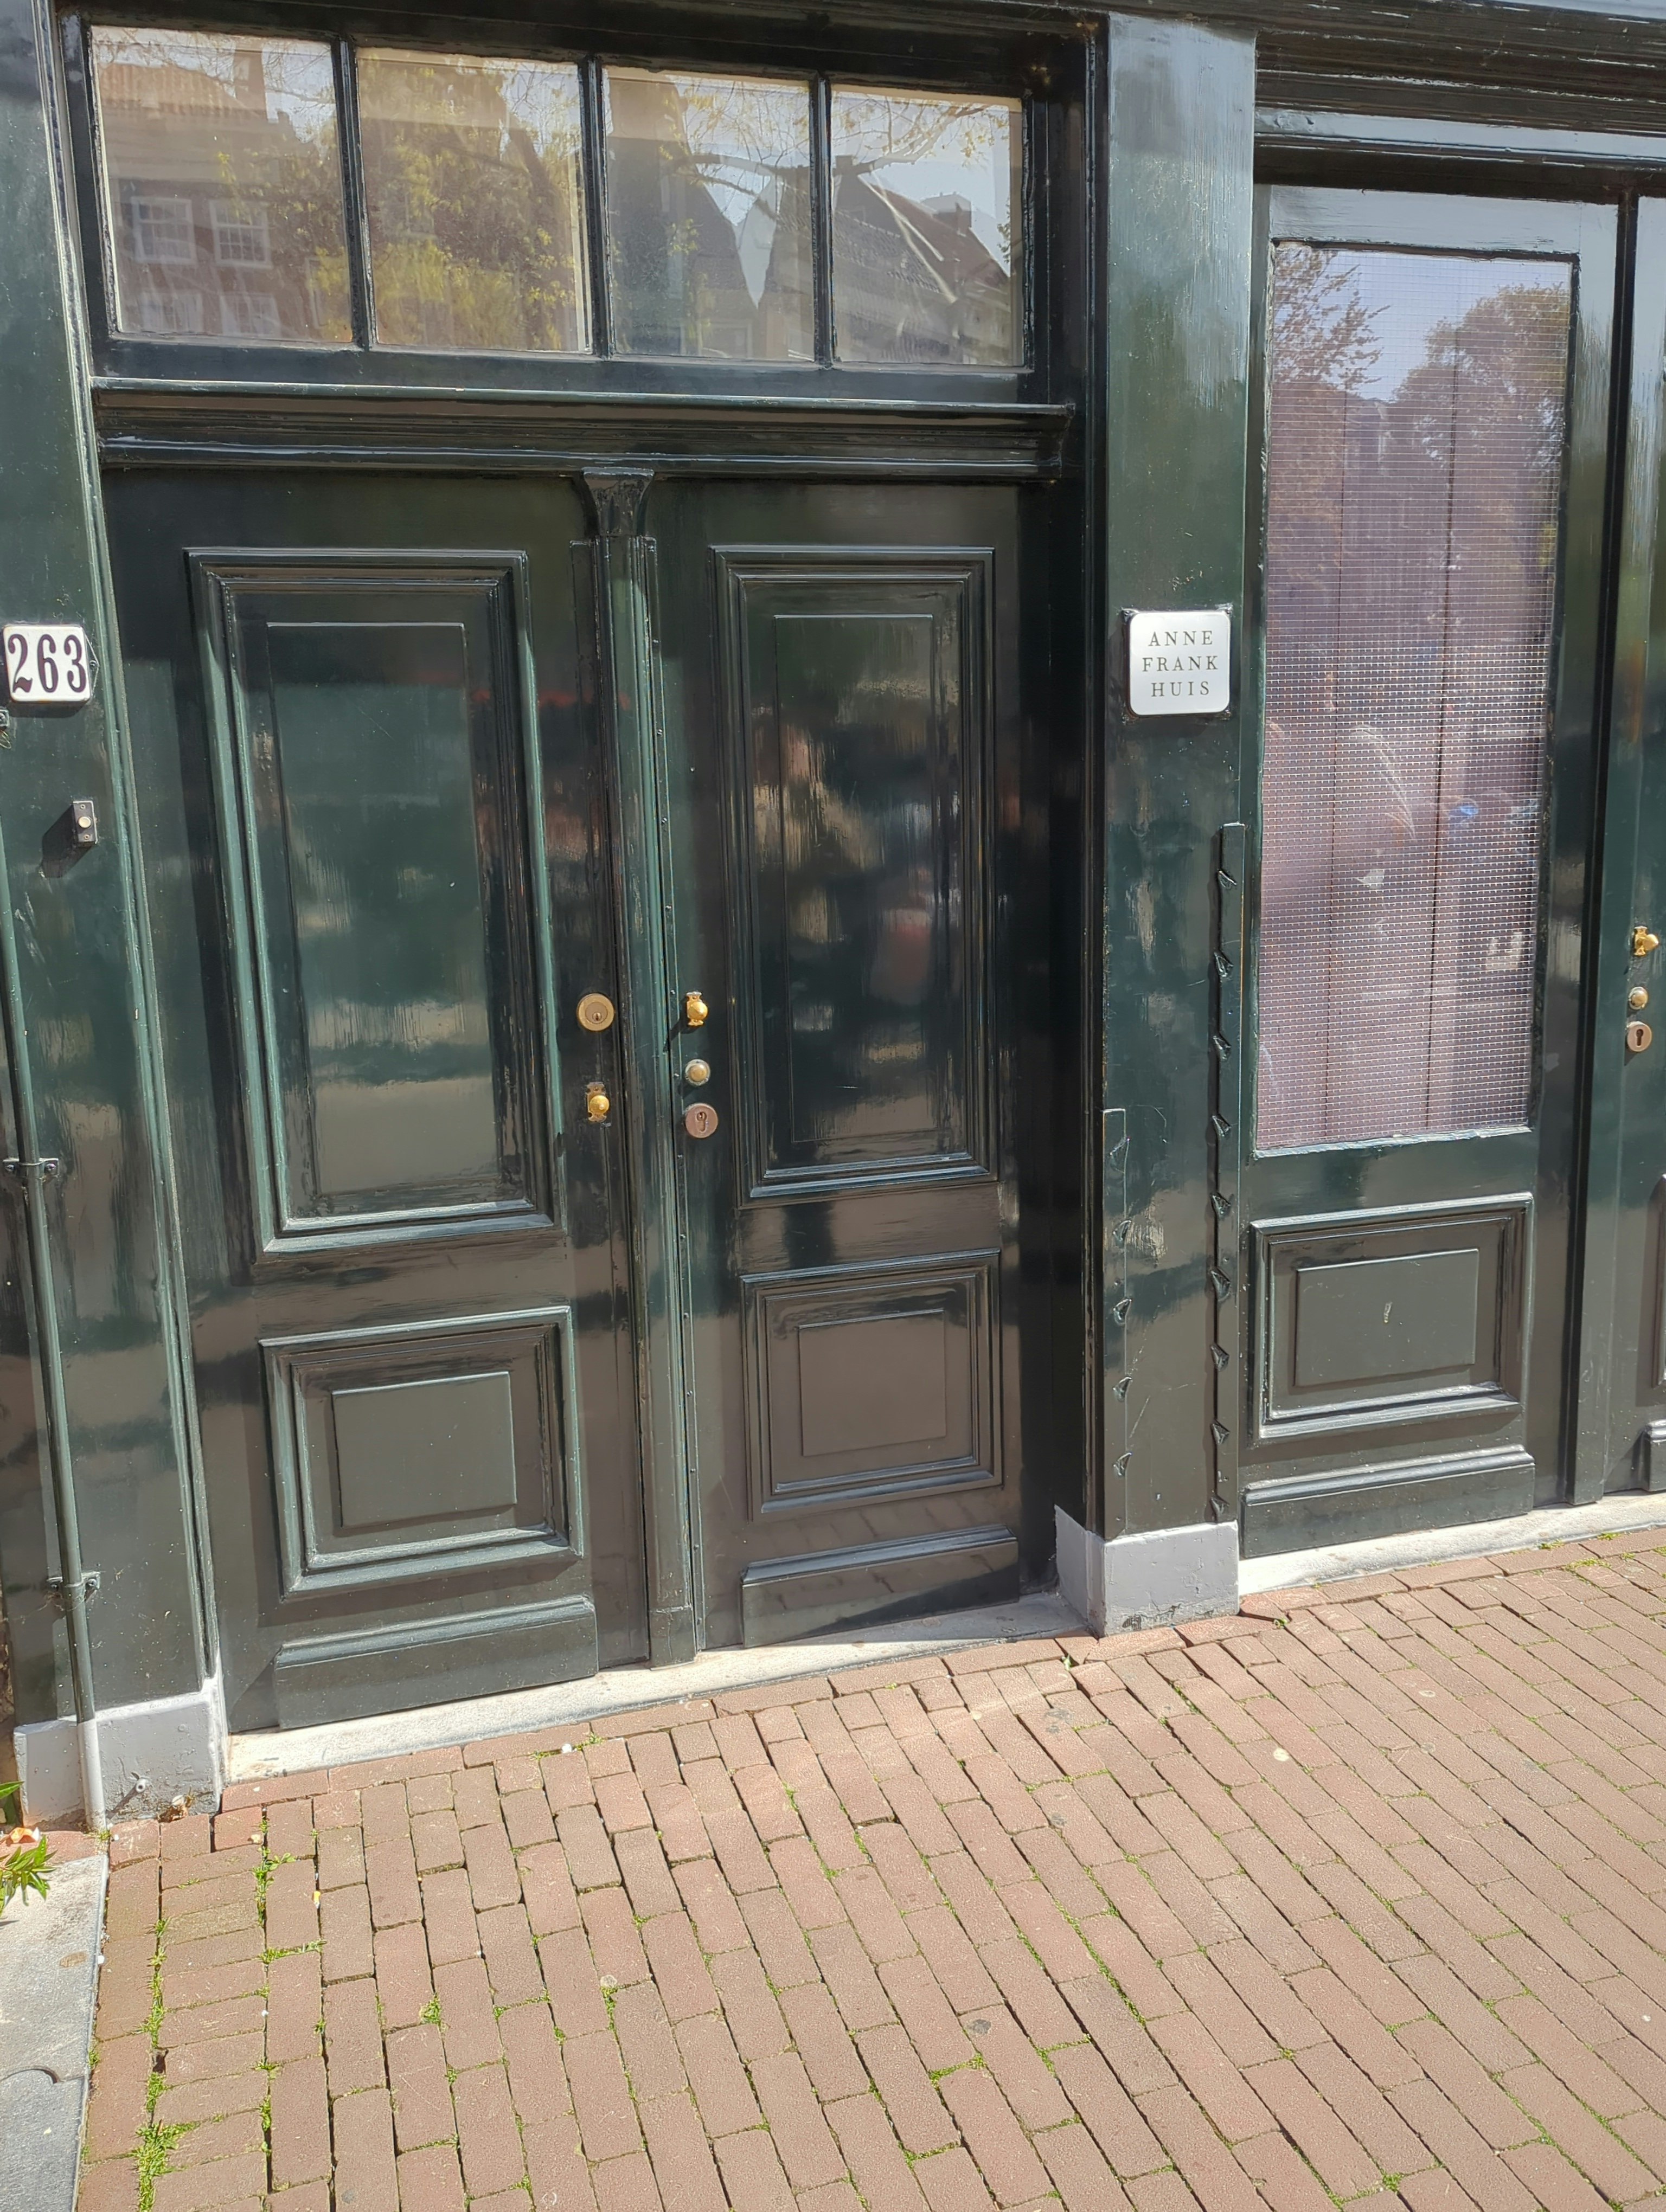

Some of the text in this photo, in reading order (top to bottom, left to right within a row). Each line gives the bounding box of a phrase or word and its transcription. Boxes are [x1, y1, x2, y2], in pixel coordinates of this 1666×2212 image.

[1148, 631, 1213, 647] ANNE
[8, 633, 86, 693] 263
[1142, 655, 1218, 672] FRANK
[1151, 681, 1209, 697] HUIS
